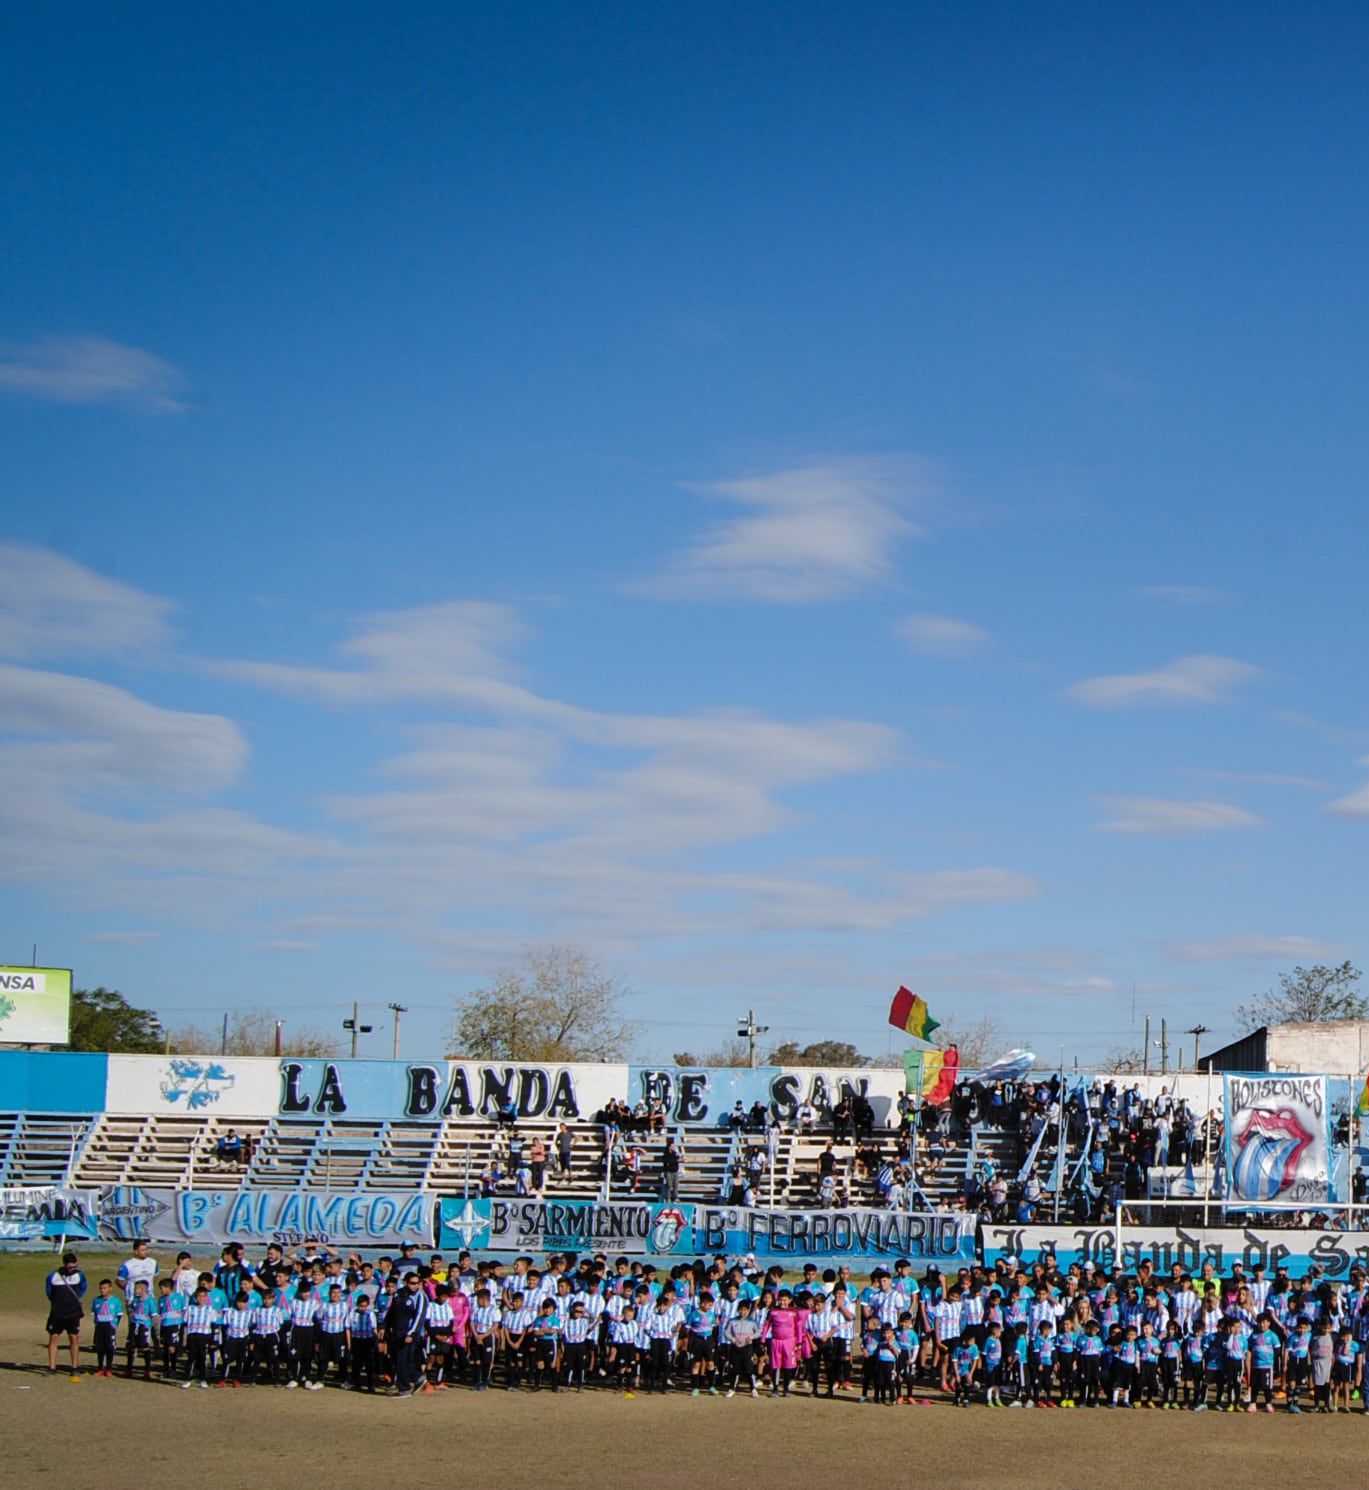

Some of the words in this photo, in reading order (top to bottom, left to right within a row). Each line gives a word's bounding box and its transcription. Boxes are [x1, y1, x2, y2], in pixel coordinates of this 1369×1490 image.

[281, 1062, 347, 1113] LA
[404, 1065, 581, 1118] BANDA
[641, 1070, 710, 1122] DE
[769, 1074, 872, 1121] SAN
[0, 1198, 90, 1229] EMIA
[103, 1204, 155, 1217] ARGENTINO
[226, 1191, 427, 1238] ALAMEDA
[520, 1203, 651, 1238] SARMIENTO
[748, 1211, 962, 1257] FERROVIARIO
[992, 1228, 1058, 1268] La
[1073, 1227, 1227, 1276] Banda
[1243, 1228, 1291, 1275] de
